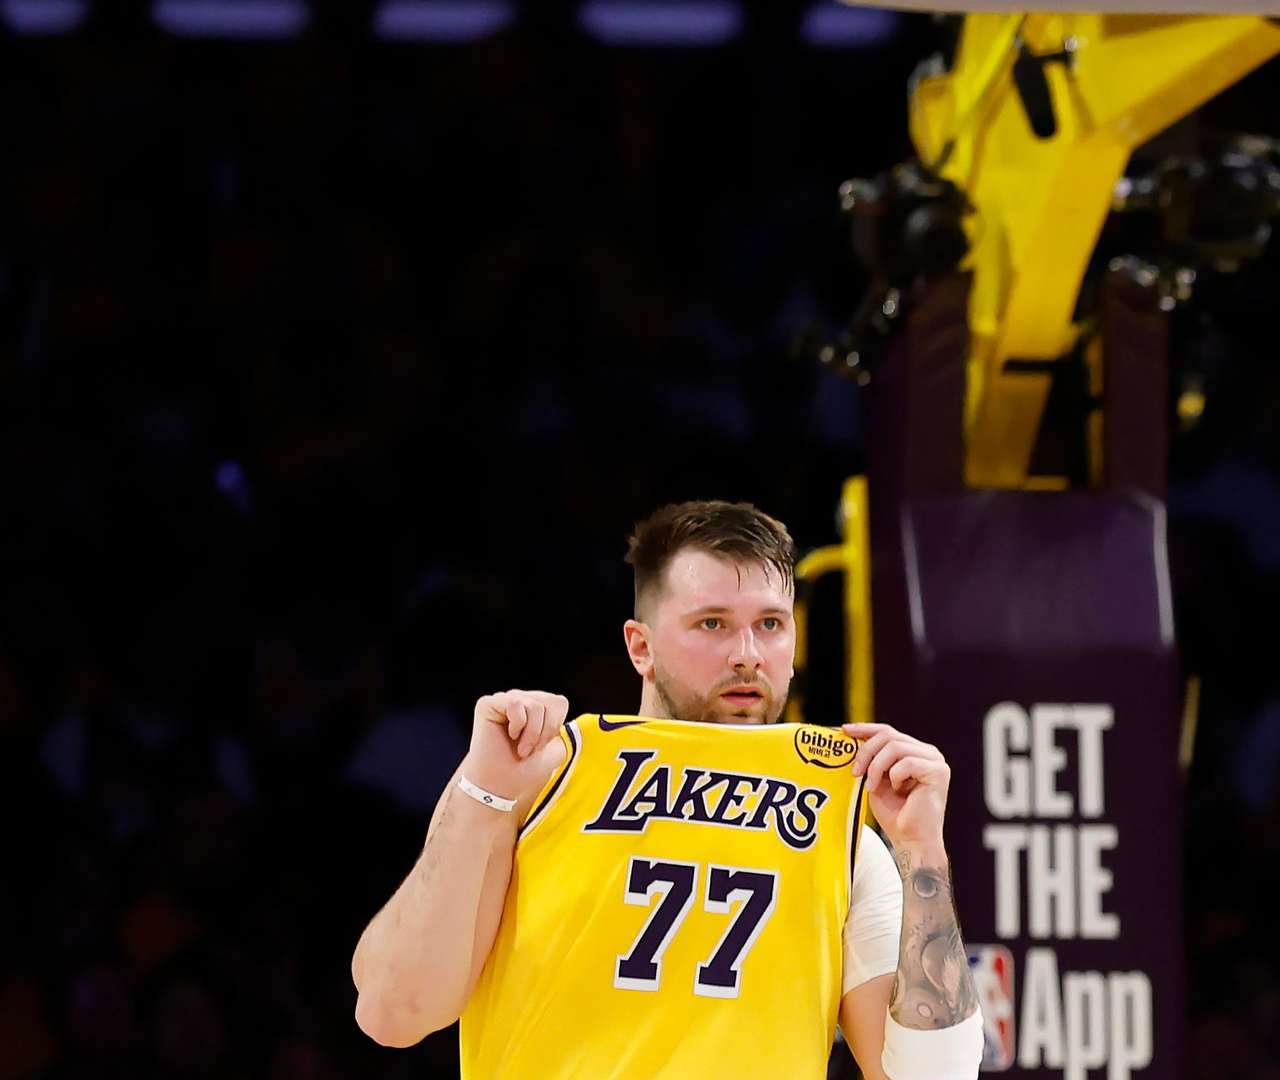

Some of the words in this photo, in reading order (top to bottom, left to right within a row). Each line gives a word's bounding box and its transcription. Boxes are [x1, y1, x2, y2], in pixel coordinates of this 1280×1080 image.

[582, 748, 829, 851] LAKERS
[801, 730, 855, 757] bibigo
[983, 701, 1115, 819] GET
[612, 855, 781, 998] 77
[983, 824, 1121, 940] THE
